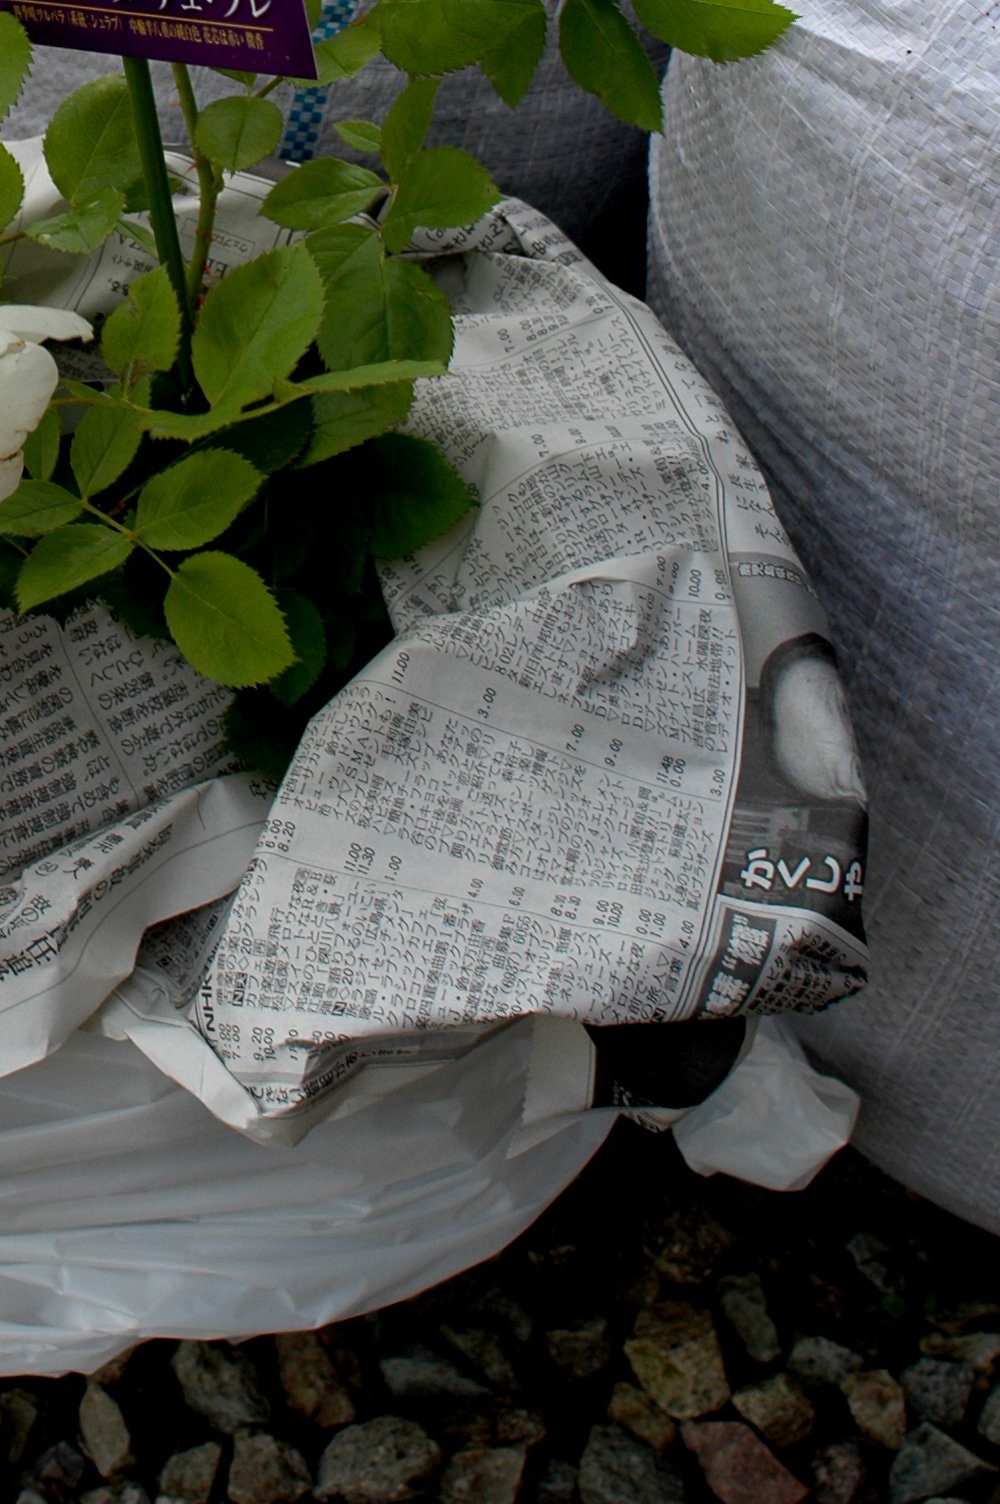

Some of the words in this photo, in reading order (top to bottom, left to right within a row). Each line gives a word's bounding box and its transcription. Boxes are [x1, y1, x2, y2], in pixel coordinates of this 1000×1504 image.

[478, 686, 496, 718] 3.00
[565, 723, 585, 752] 7.00
[603, 737, 624, 766] 9.00
[708, 768, 726, 795] 3.00
